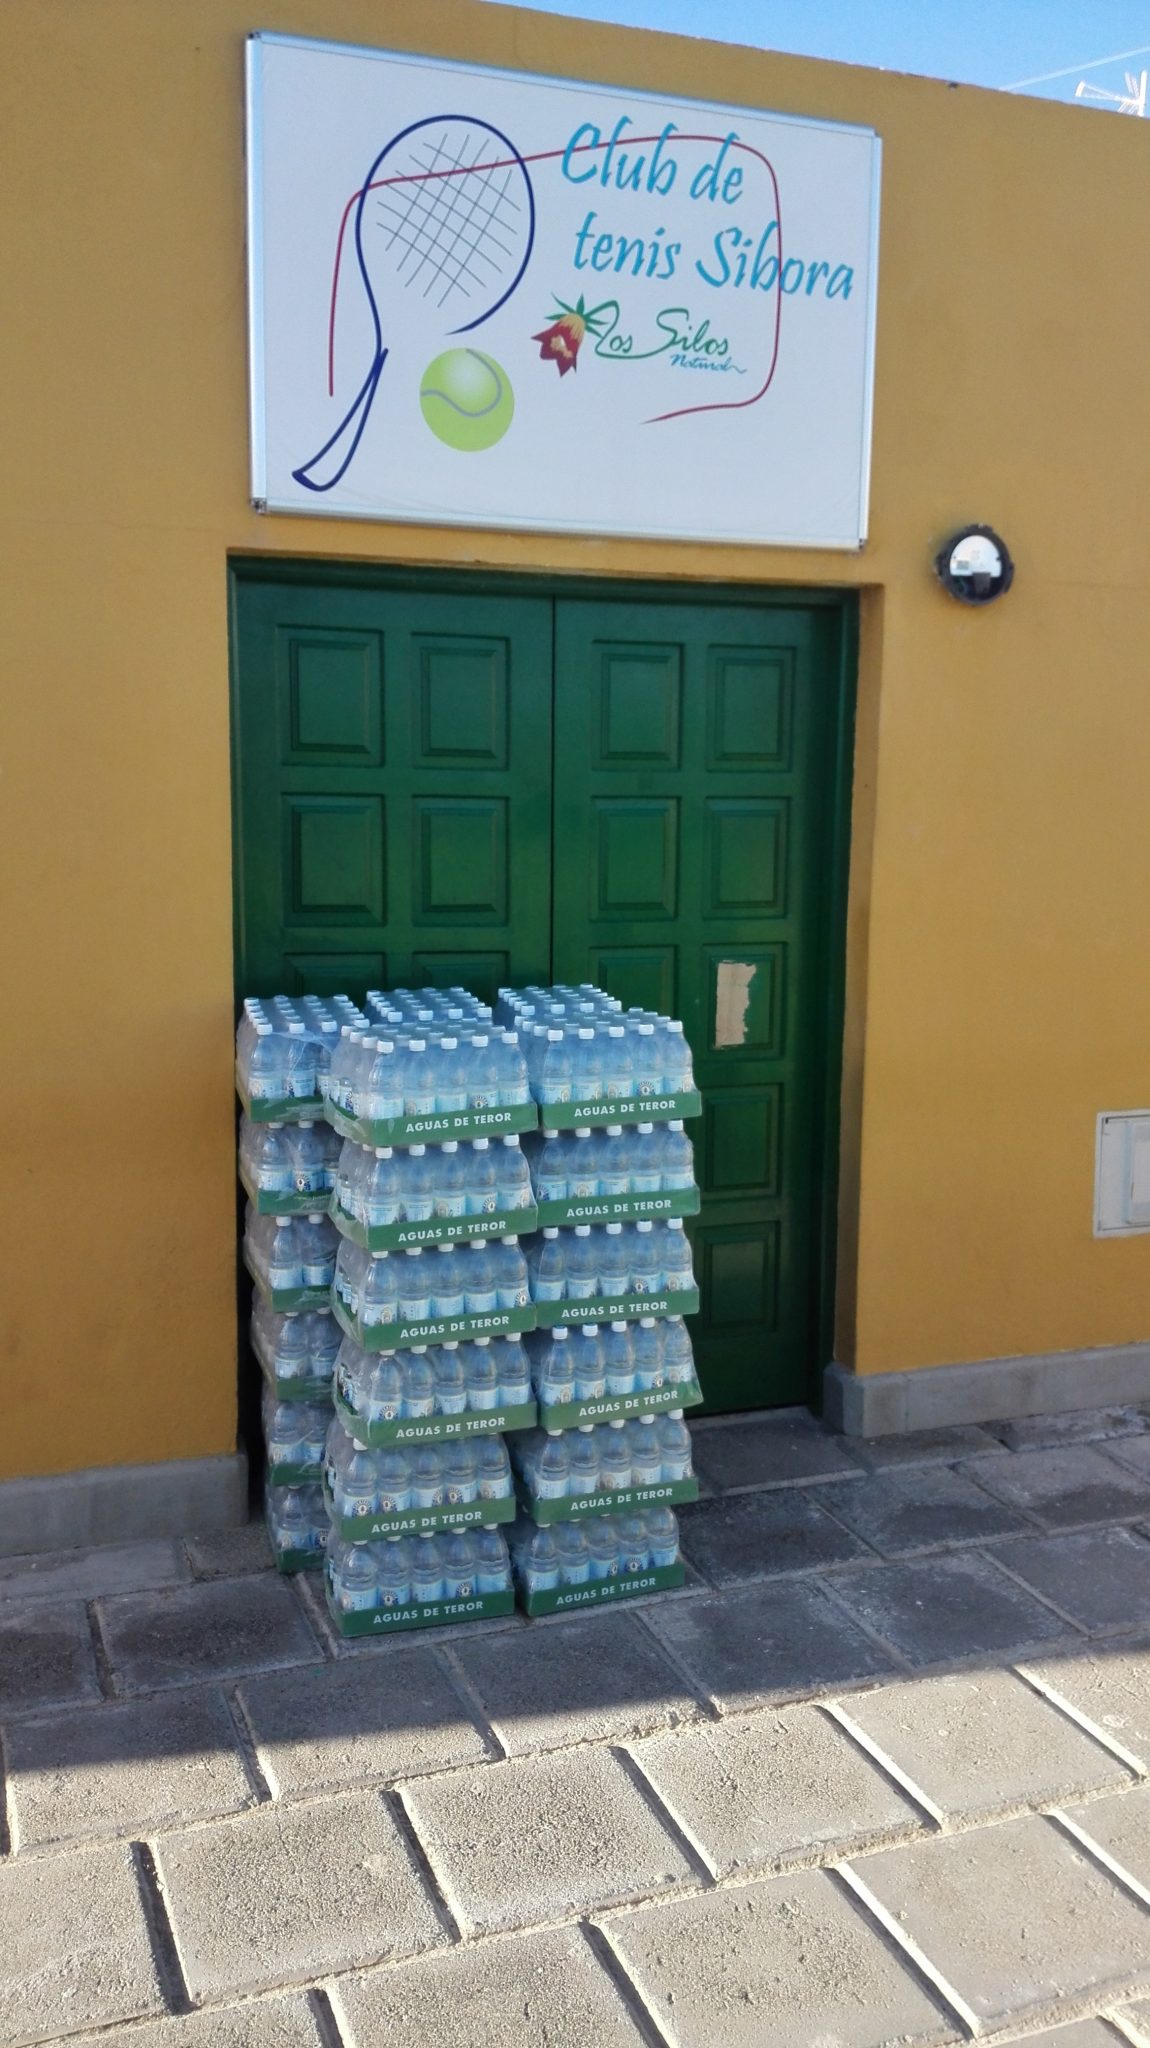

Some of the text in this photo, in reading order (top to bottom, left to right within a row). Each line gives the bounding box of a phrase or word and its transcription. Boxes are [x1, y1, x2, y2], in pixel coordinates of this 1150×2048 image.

[561, 115, 744, 204] Club de
[573, 211, 855, 300] tenis Sibora
[656, 307, 729, 357] Silos
[670, 352, 748, 374] Natural
[574, 1099, 676, 1118] AGUAS DE TEROR
[405, 1112, 512, 1133] AGUAS DE TEROR
[566, 1199, 672, 1218] AGUAS DE TEROR
[398, 1220, 506, 1242] AGUAS DE TEROR
[561, 1301, 668, 1318] AGUAS DE TEROR
[400, 1315, 510, 1339] AGUAS DE TEROR
[579, 1390, 678, 1417] AGUAS DE TEROR
[395, 1416, 506, 1439] AGUAS DE TEROR
[570, 1487, 673, 1511] AGUAS DE TEROR
[371, 1511, 482, 1534] AGUAS DE TEROR
[556, 1577, 656, 1605] AGUAS DE TEROR
[373, 1600, 484, 1624] AGUAS DE TEROR
